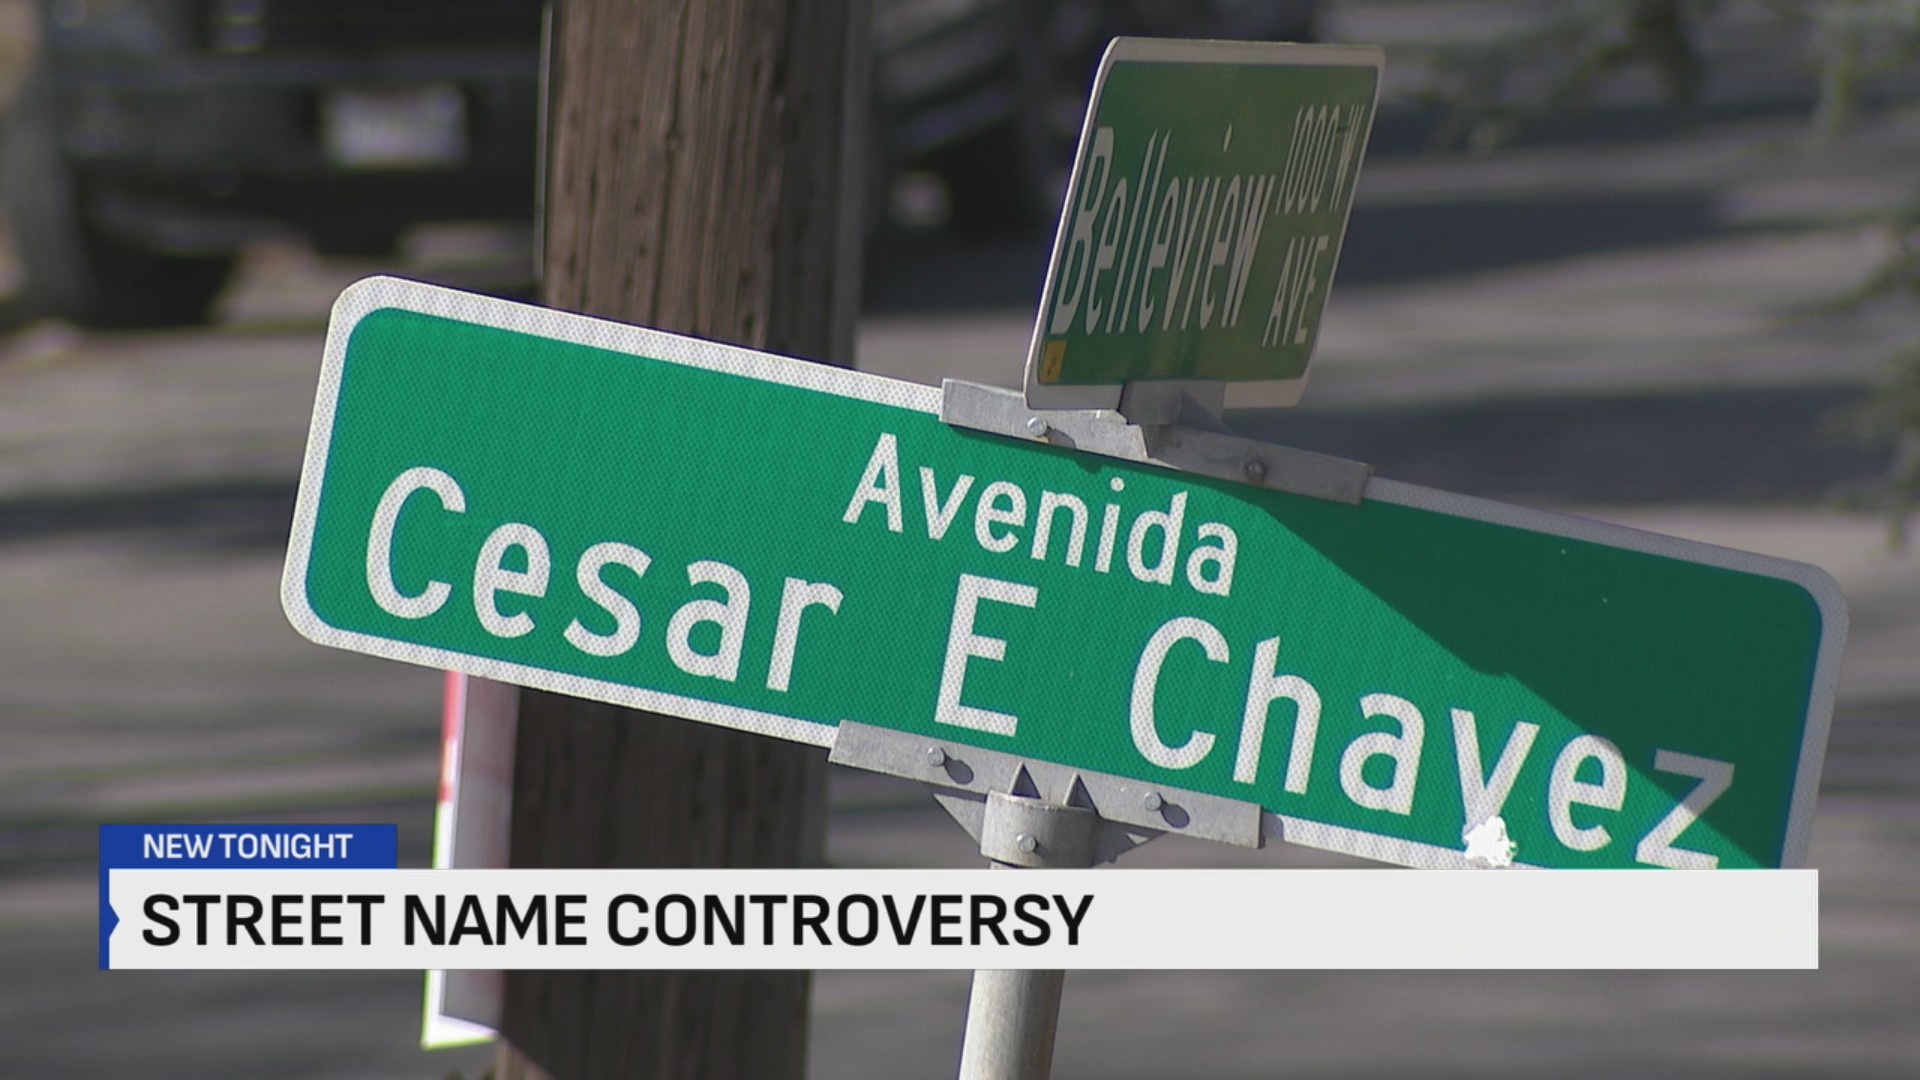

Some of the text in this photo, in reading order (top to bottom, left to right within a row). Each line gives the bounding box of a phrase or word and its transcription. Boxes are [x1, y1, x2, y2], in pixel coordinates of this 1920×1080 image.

[1050, 126, 1275, 335] Belleview
[1275, 104, 1341, 215] 1000
[1262, 235, 1329, 347] AVE
[843, 433, 1238, 597] Avenida
[366, 467, 1735, 869] Cesar E Chavez
